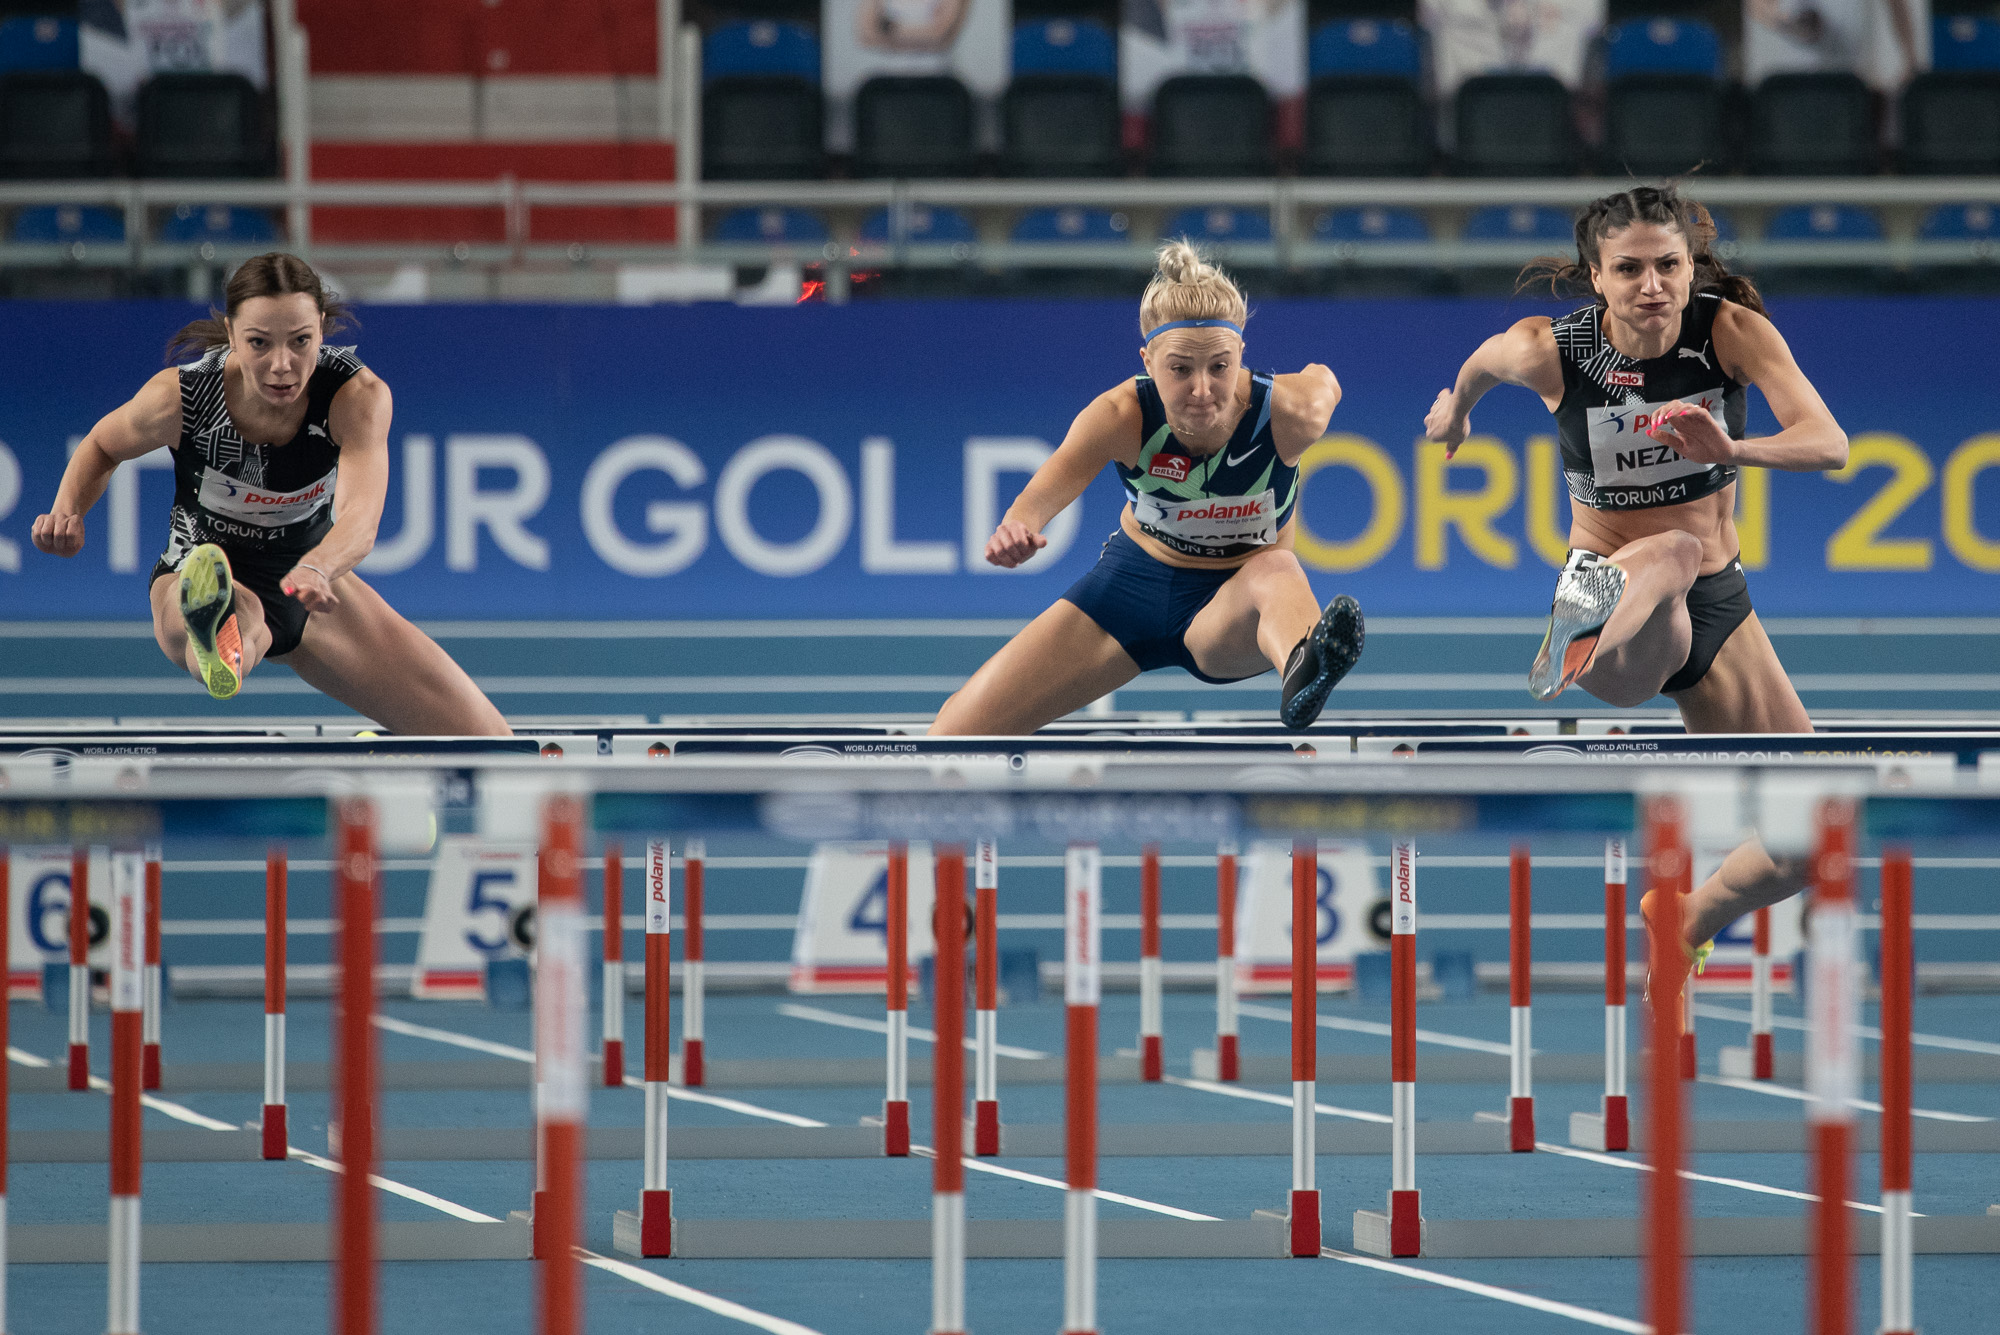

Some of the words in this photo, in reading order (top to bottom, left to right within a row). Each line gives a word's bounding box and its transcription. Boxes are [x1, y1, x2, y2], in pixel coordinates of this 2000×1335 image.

[1612, 373, 1639, 385] helo
[1154, 468, 1183, 479] ORLEN
[244, 481, 326, 504] polanik
[1605, 486, 1665, 506] TORUŃ
[1668, 483, 1687, 500] 21
[66, 433, 551, 574] TUR
[580, 433, 1085, 577] GOLD
[1177, 500, 1262, 521] polanik
[205, 515, 263, 540] TORUŃ
[267, 527, 286, 540] 21
[1206, 548, 1225, 556] 21
[83, 747, 113, 755] WORLD
[113, 747, 157, 755] ATHLETICS
[844, 744, 873, 752] WORLD
[874, 744, 917, 752] ATHLETICS
[1586, 743, 1615, 751] WORLD
[1616, 743, 1659, 751] ATHLETICS
[650, 840, 666, 903] polanik
[1396, 842, 1413, 904] polanik
[466, 872, 517, 950] 5
